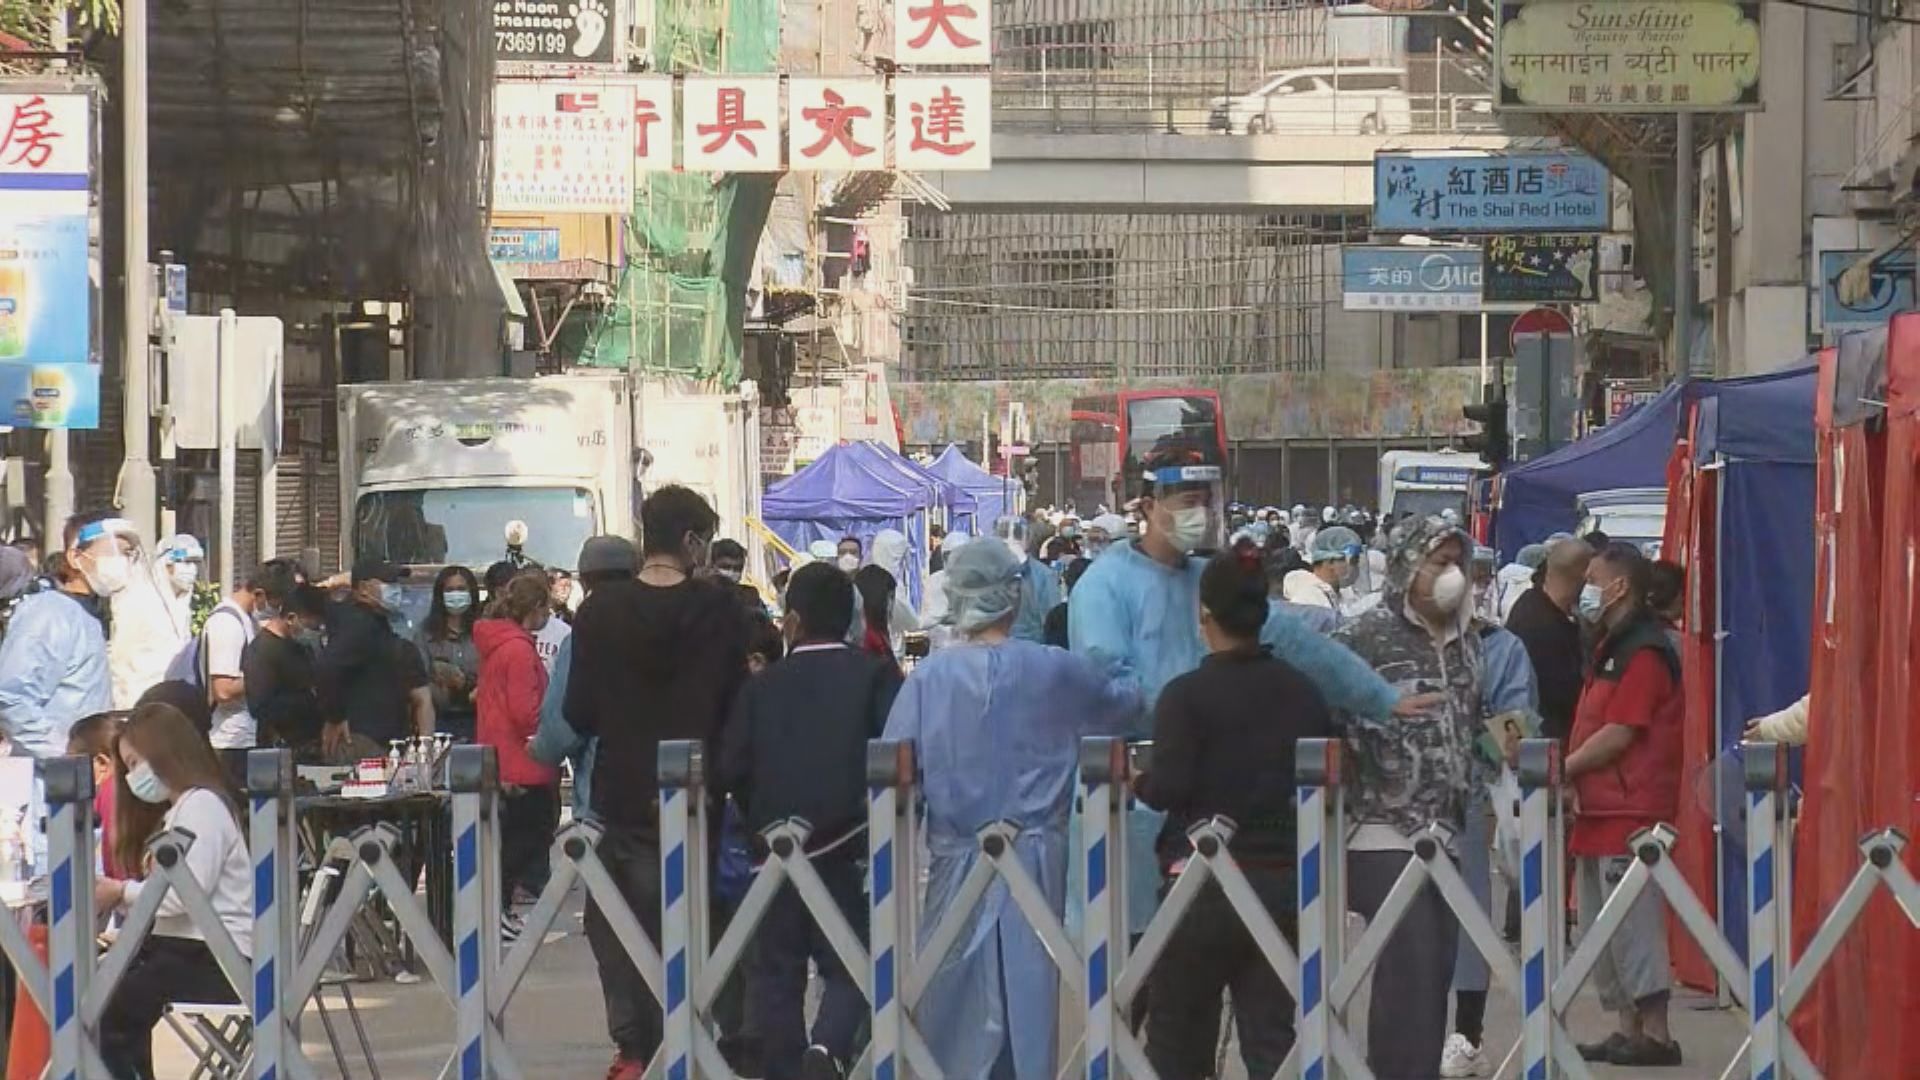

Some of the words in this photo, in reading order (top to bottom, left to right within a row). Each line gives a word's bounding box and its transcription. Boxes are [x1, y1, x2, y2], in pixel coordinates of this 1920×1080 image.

[1568, 3, 1694, 30] Sunshine
[0, 95, 64, 167] 房
[1447, 166, 1543, 196] 紅酒店
[1448, 202, 1478, 217] The
[1483, 201, 1514, 217] Shai
[1519, 202, 1549, 217] Red
[1555, 201, 1596, 217] Hotel
